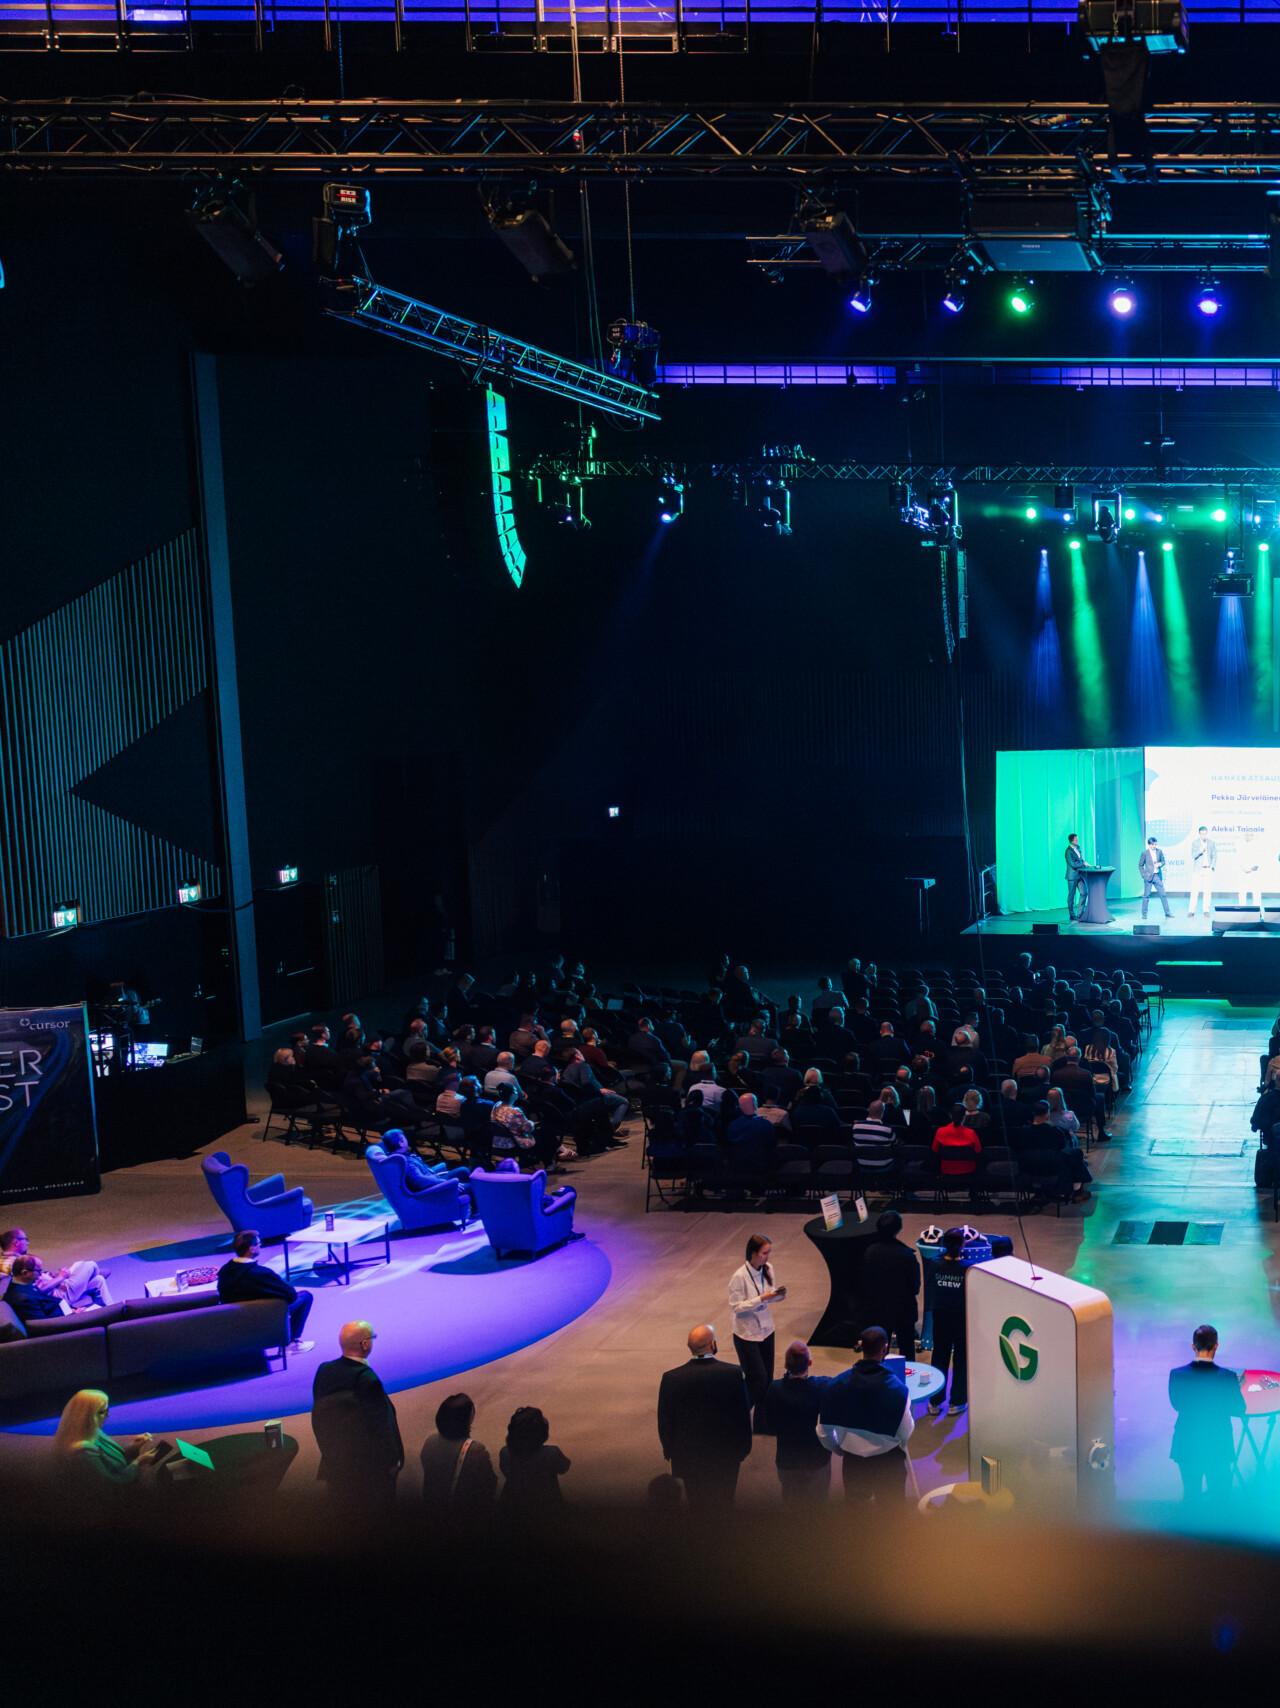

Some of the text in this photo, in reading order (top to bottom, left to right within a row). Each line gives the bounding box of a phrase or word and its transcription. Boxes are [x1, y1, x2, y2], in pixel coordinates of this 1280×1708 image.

[29, 1020, 71, 1031] cursor
[937, 1280, 961, 1288] CREW
[999, 1316, 1039, 1381] G
